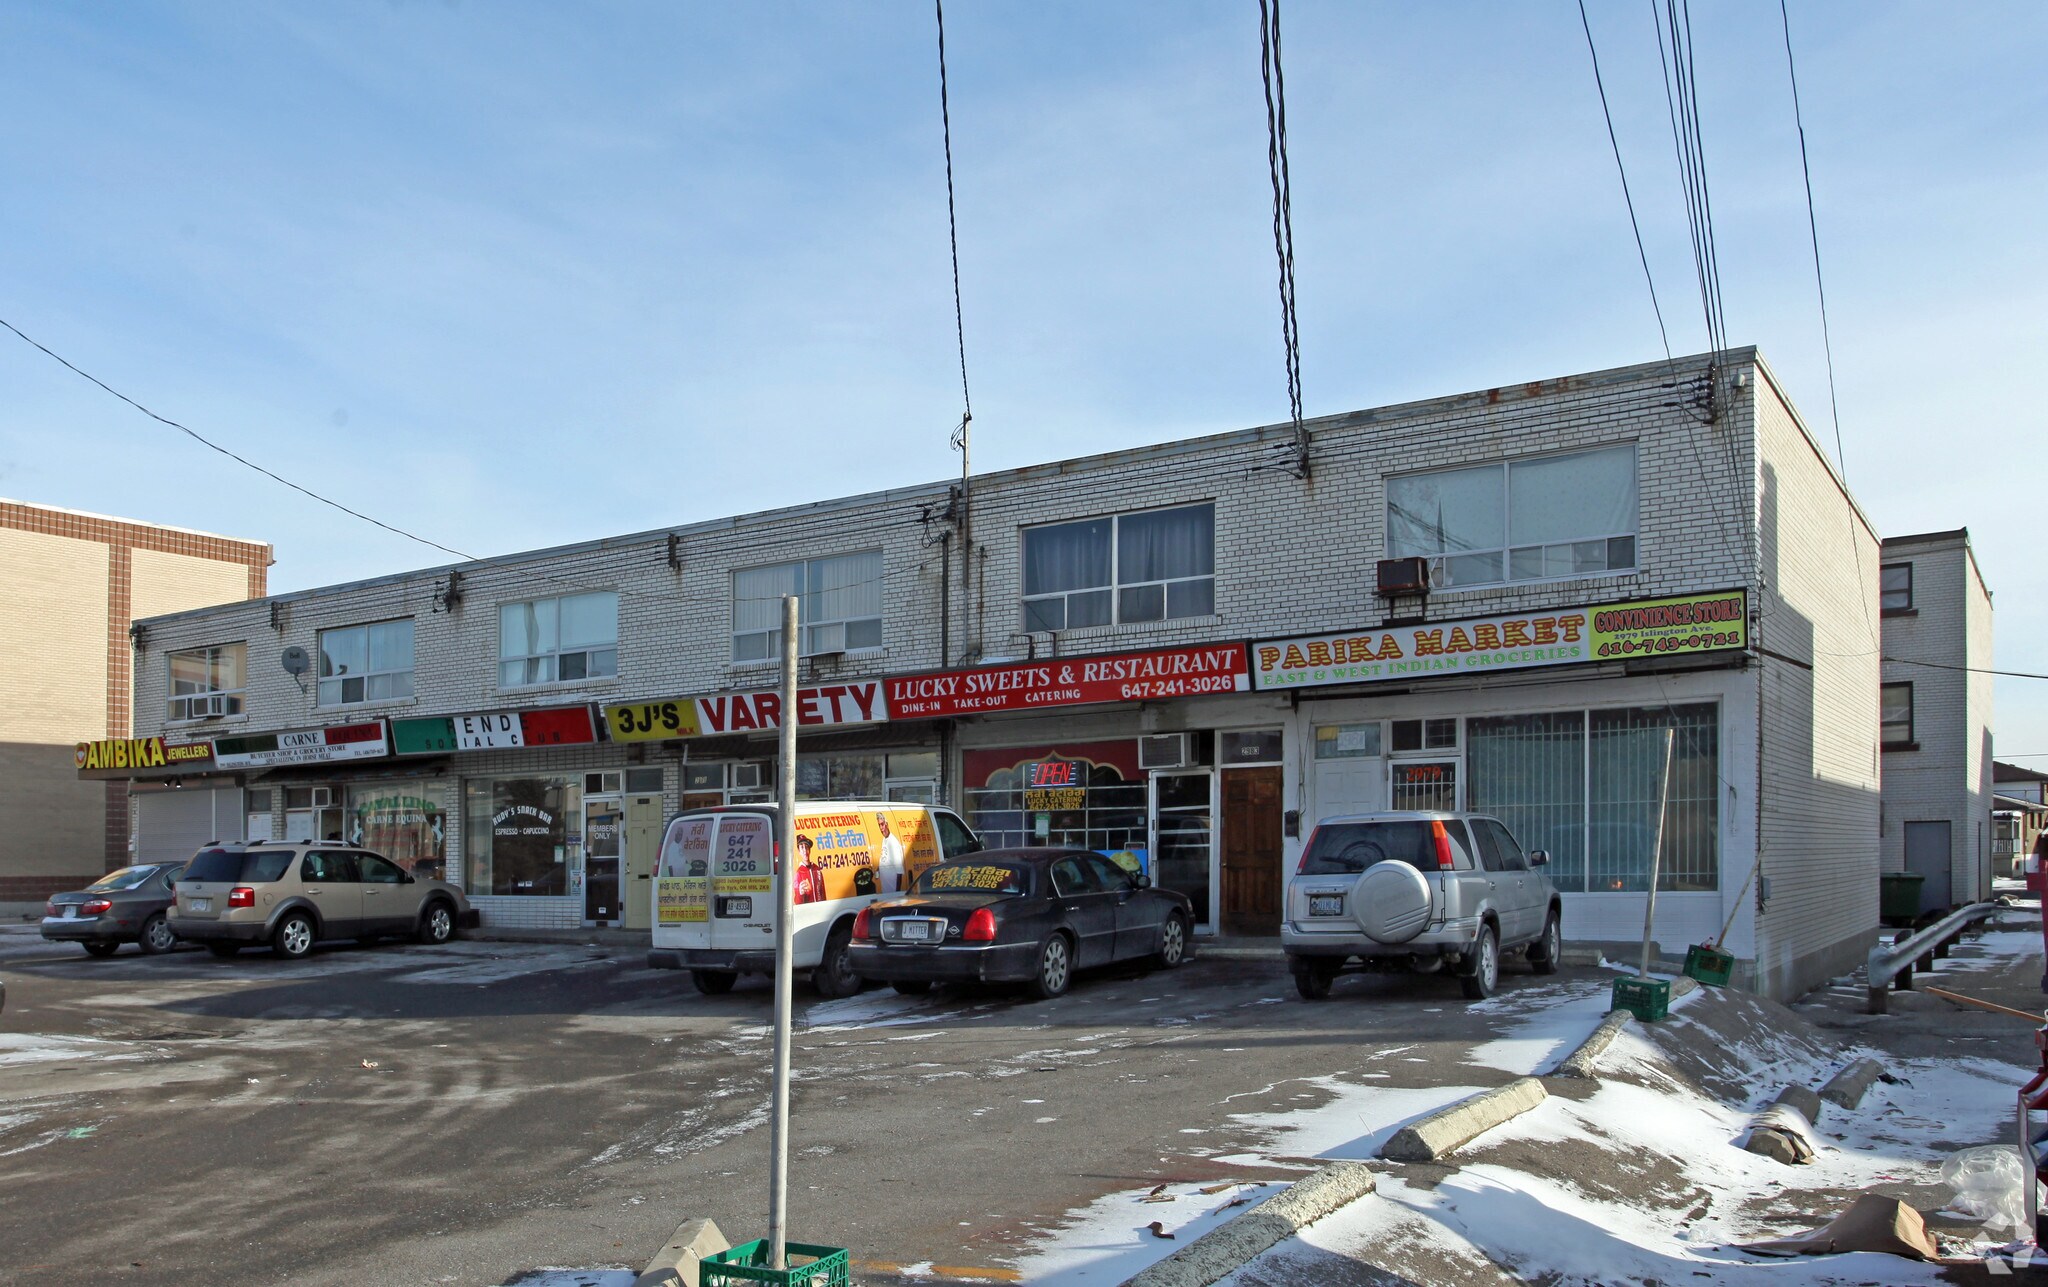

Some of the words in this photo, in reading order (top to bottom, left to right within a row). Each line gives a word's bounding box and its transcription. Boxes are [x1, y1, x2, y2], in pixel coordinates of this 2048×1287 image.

[1595, 603, 1692, 633] CONVINIENCE
[1693, 598, 1741, 623] STORE
[1614, 632, 1638, 640] 2979
[1641, 628, 1687, 637] Islington
[1691, 625, 1714, 633] Ave.
[1258, 634, 1403, 671] PARIKA
[1413, 614, 1585, 656] MARKET
[1598, 631, 1739, 657] 416-743-0721
[1263, 671, 1307, 685] EAST
[1313, 670, 1326, 680] &
[1333, 664, 1382, 679] WEST
[1388, 658, 1459, 674] INDIAN
[1465, 646, 1581, 666] GROCERIES
[894, 676, 960, 700] LUCKY
[965, 667, 1050, 694] SWEETS
[1058, 665, 1076, 685] &
[1082, 649, 1237, 683] RESTAURANT
[1121, 675, 1232, 698] 647-241-3026
[699, 683, 876, 732] VARETY
[902, 702, 941, 714] DINE-IN
[953, 695, 1007, 709] TAKE-OUT
[1025, 689, 1081, 703] CATERING
[618, 703, 680, 733] 3J'S
[283, 732, 319, 747] CARNE
[86, 737, 166, 769] AMBIKA
[167, 745, 209, 760] JEWELLERS
[250, 751, 276, 760] BUTCHER
[1033, 762, 1072, 785] OPEN
[1406, 766, 1441, 782] 2979
[366, 814, 393, 824] CARNE
[396, 814, 427, 825] EQUINA
[492, 808, 515, 826] RUDY'S
[517, 805, 537, 816] SNACK
[539, 810, 553, 825] BAR
[794, 817, 820, 831] LUCKY
[820, 815, 860, 828] CATERING
[495, 827, 518, 835] ESPRESSO
[523, 827, 550, 835] CAPUCCINO
[736, 822, 762, 833] CATERING
[594, 832, 611, 840] ONLY
[728, 835, 754, 847] 647
[727, 848, 751, 859] 241
[817, 852, 870, 870] 647-241-3026
[722, 860, 756, 872] 3026
[932, 874, 958, 882] LUCKY
[960, 873, 1004, 882] CATERING
[932, 880, 998, 889] 647-241-3026
